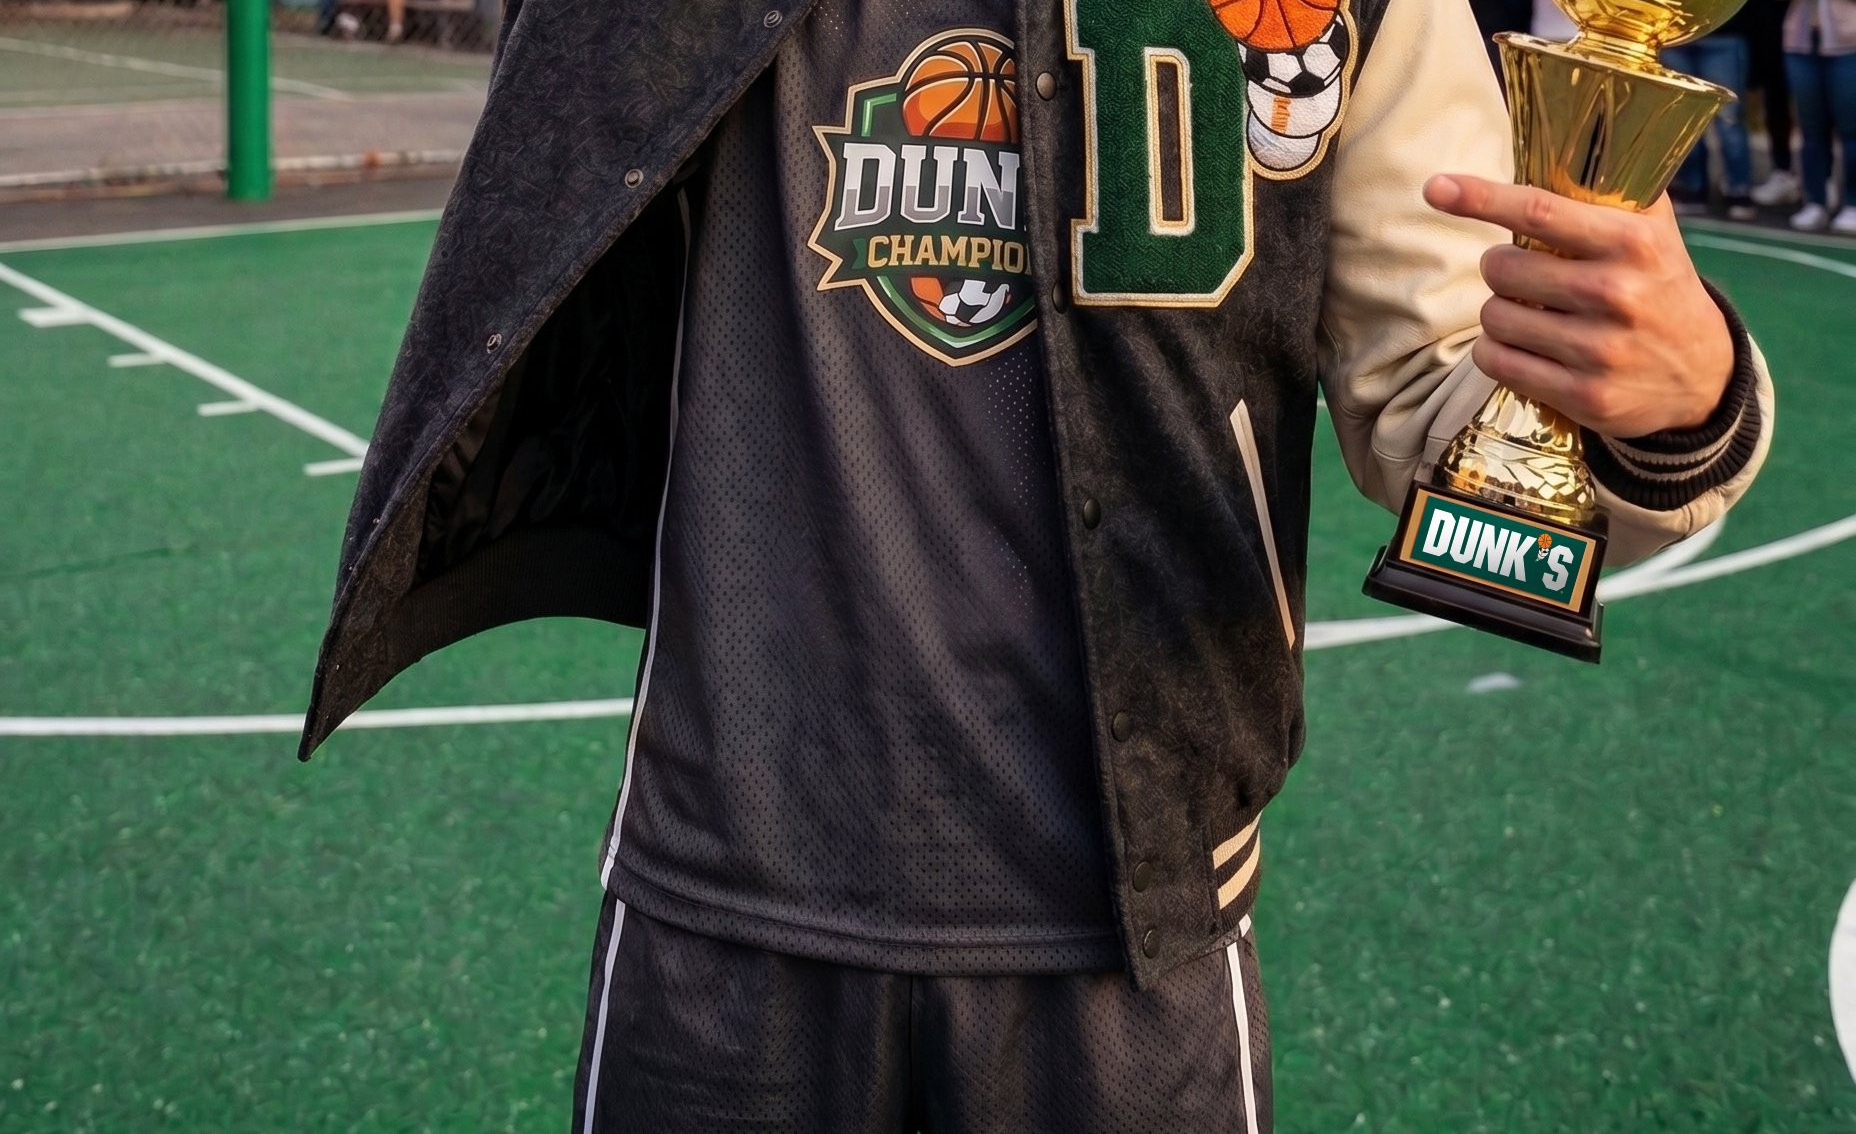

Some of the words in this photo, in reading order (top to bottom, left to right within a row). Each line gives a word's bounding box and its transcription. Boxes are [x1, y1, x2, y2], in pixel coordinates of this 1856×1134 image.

[834, 142, 1027, 232] DUN
[866, 234, 1032, 276] CHAMPIO
[1422, 508, 1575, 592] DUNK'S
